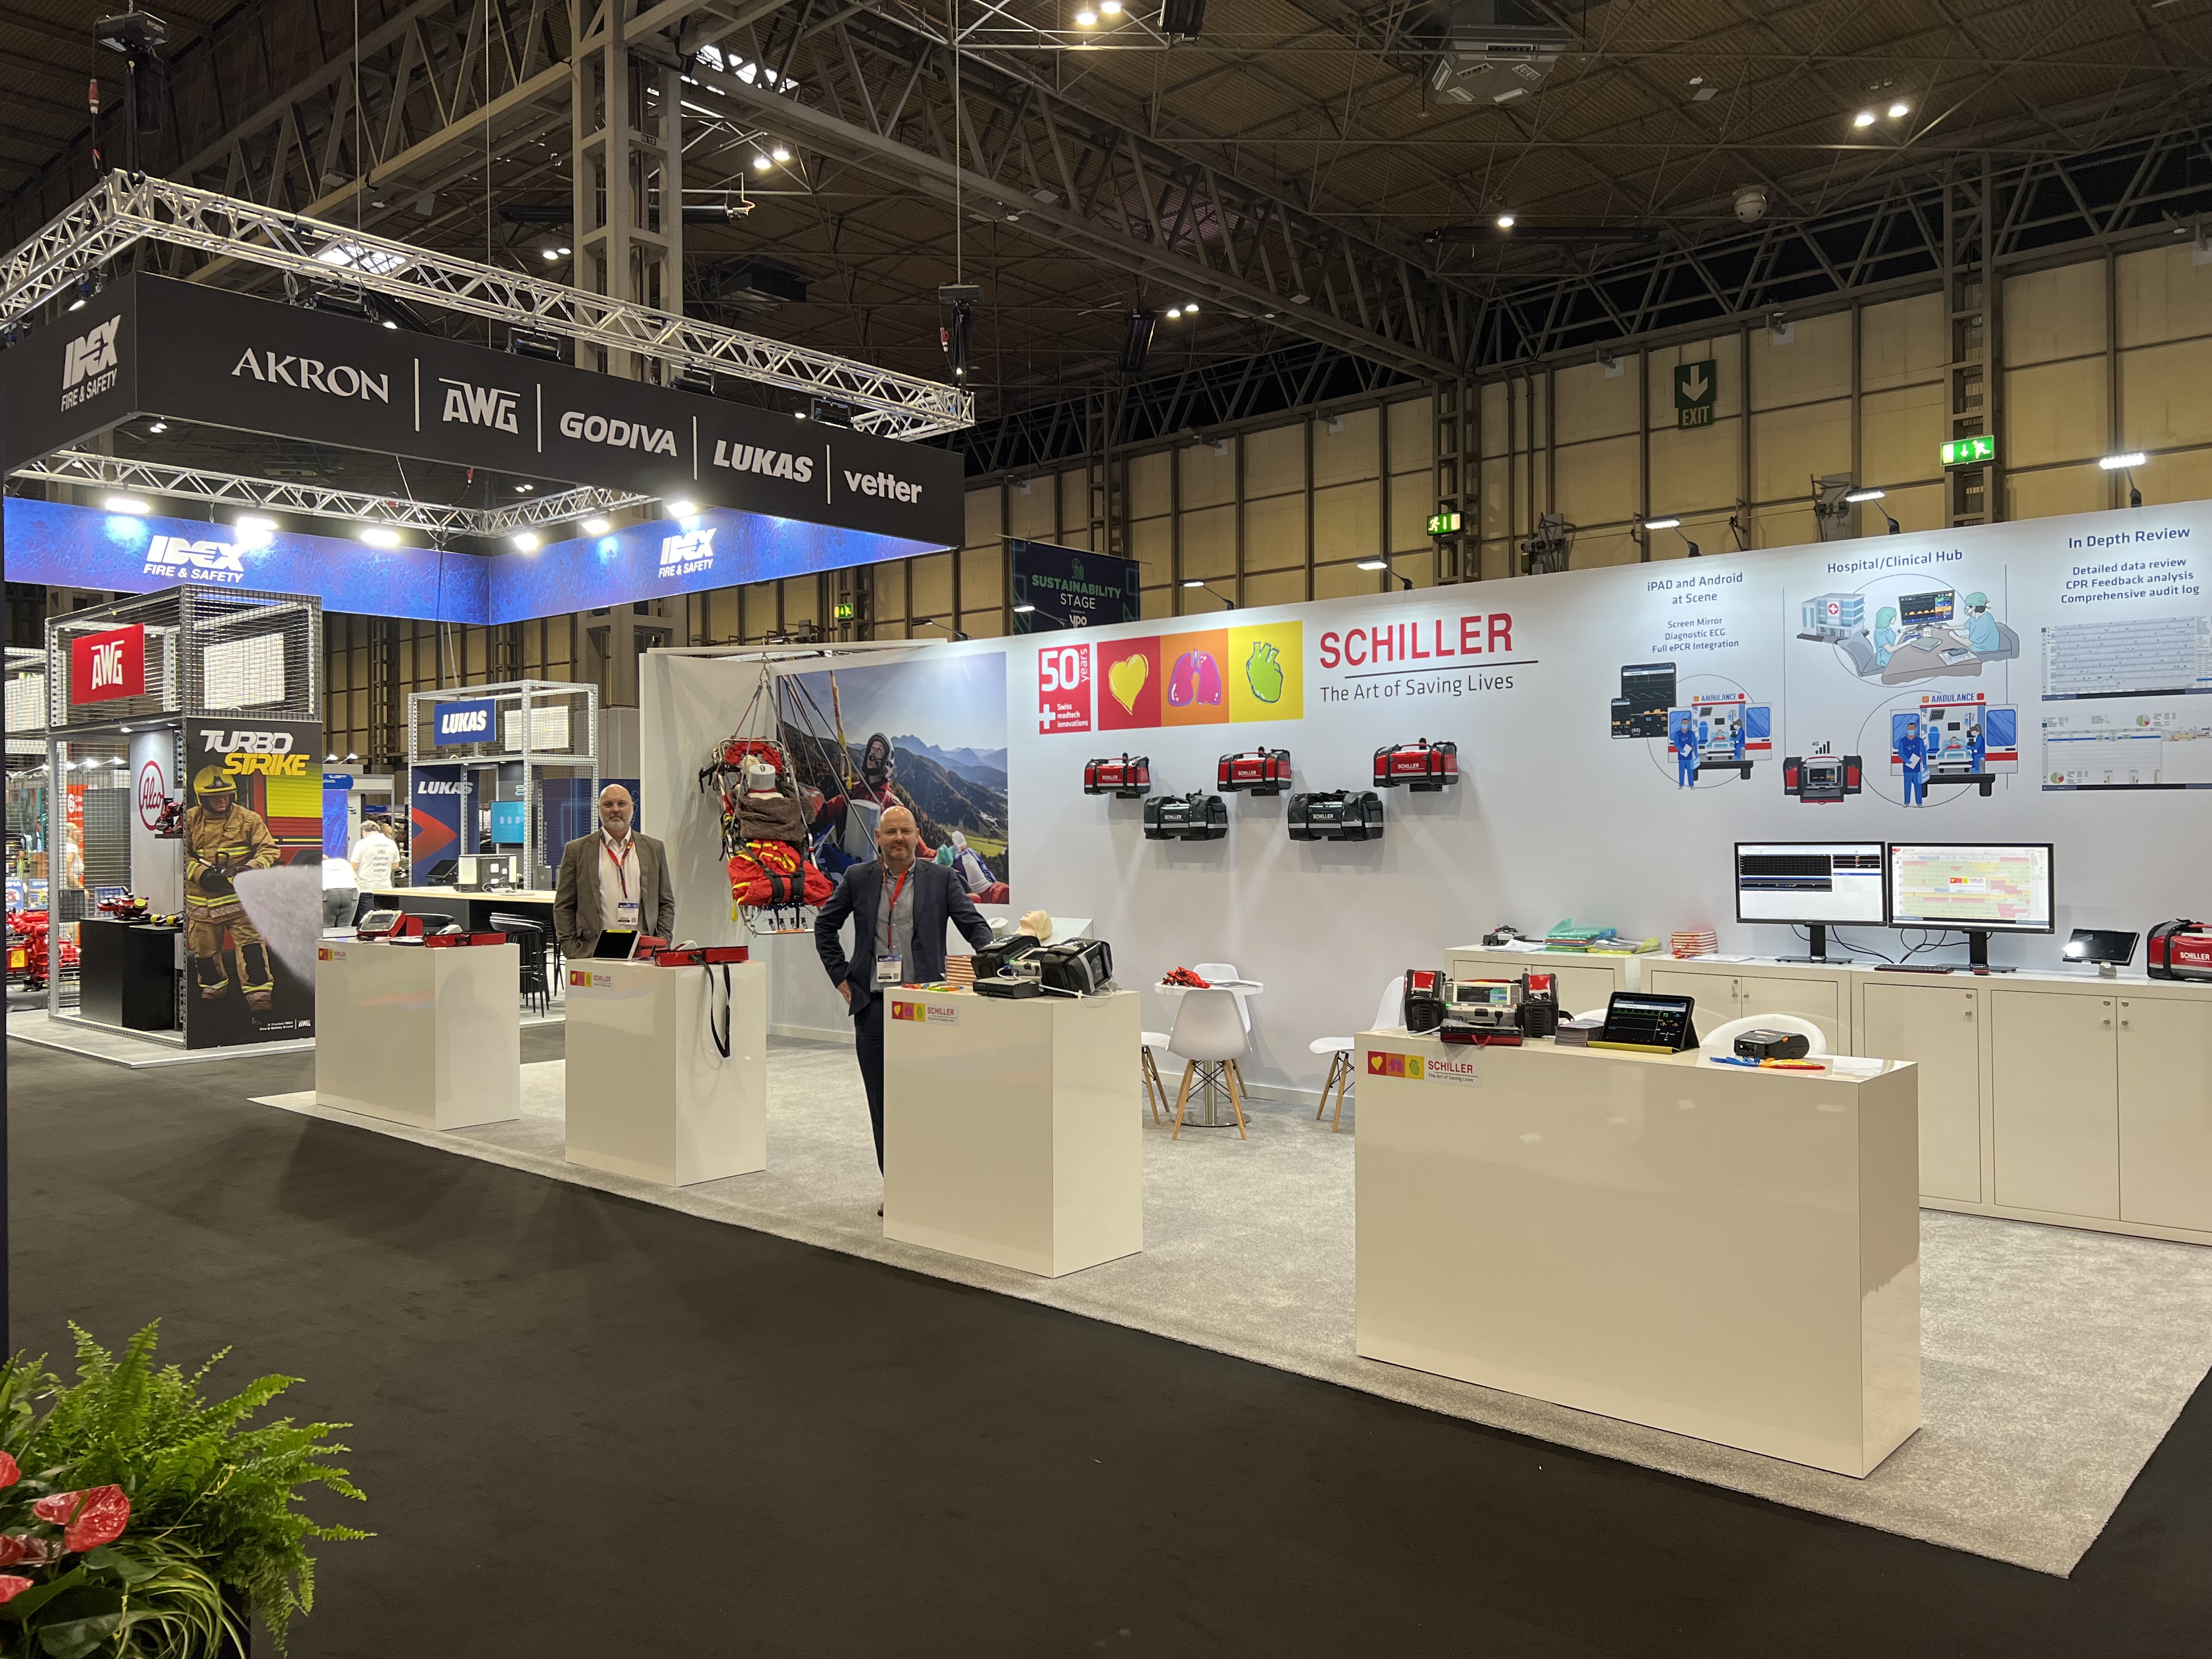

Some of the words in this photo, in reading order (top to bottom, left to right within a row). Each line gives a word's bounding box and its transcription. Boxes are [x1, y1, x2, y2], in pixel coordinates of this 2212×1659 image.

[63, 314, 121, 390] IDEX
[231, 347, 390, 404] AKRON
[61, 388, 78, 412] FIRE
[78, 385, 85, 403] &
[86, 368, 117, 400] SAFETY
[438, 377, 521, 435] AWG
[1683, 406, 1709, 426] EXIT
[560, 410, 678, 457] GODIVA
[713, 439, 814, 483] LUKAS
[844, 469, 923, 504] vetter
[660, 528, 716, 565] IDEX
[2069, 538, 2082, 548] In
[2087, 532, 2130, 548] Depth
[2135, 528, 2191, 542] Review
[146, 535, 251, 572] IDEX
[1827, 552, 1932, 574] Hospital/Clinical
[1936, 549, 1963, 562] Hub
[143, 563, 176, 577] FIRE
[177, 567, 188, 578] &
[190, 568, 244, 583] SAFETY
[658, 565, 676, 578] FIRE
[676, 564, 682, 575] &
[683, 558, 714, 574] SAFETY
[2073, 563, 2118, 575] Detailed
[2121, 562, 2146, 571] data
[2149, 558, 2187, 569] review
[1032, 574, 1122, 599] SUSTAINABILITY
[1647, 580, 1673, 591] iPAD
[1676, 577, 1695, 588] and
[1699, 572, 1743, 586] Android
[2066, 580, 2088, 590] CPR
[2091, 575, 2145, 588] Feedback
[2147, 571, 2194, 583] analysis
[1060, 592, 1096, 610] STAGE
[1672, 595, 1683, 605] at
[1685, 593, 1718, 603] Scene
[2061, 589, 2146, 603] Comprehensive
[2149, 585, 2179, 596] audit
[2182, 585, 2200, 595] log
[1668, 620, 1695, 629] Screen
[1697, 618, 1723, 626] Mirror
[1319, 613, 1513, 668] SCHILLER
[1665, 629, 1708, 641] Diagnostic
[1709, 628, 1726, 636] ECG
[1652, 644, 1667, 653] Full
[1669, 642, 1691, 652] ePCR
[1693, 640, 1739, 651] Integration
[91, 640, 125, 690] AWG
[1041, 648, 1080, 692] 50
[1080, 648, 1090, 682] years
[1320, 686, 1349, 702] The
[1353, 684, 1379, 700] Art
[1384, 680, 1401, 697] of
[1406, 677, 1462, 696] Saving
[1468, 674, 1514, 691] Lives
[1701, 693, 1736, 702] AMBULANCE
[1932, 693, 1974, 703] AMBULANCE
[1057, 703, 1073, 711] Swiss
[1057, 710, 1080, 719] medtech
[441, 710, 487, 734] LUKAS
[1057, 719, 1089, 729] innovations
[200, 730, 294, 754] TURBO
[222, 753, 311, 776] STRIKE
[140, 776, 163, 810] Alco
[417, 781, 474, 794] LUKAS
[2180, 952, 2210, 961] SCHILLER
[593, 974, 611, 983] SCHILLER
[928, 1007, 954, 1015] SCHILLER
[298, 1019, 311, 1028] AWG
[1428, 1060, 1473, 1074] SCHILLER
